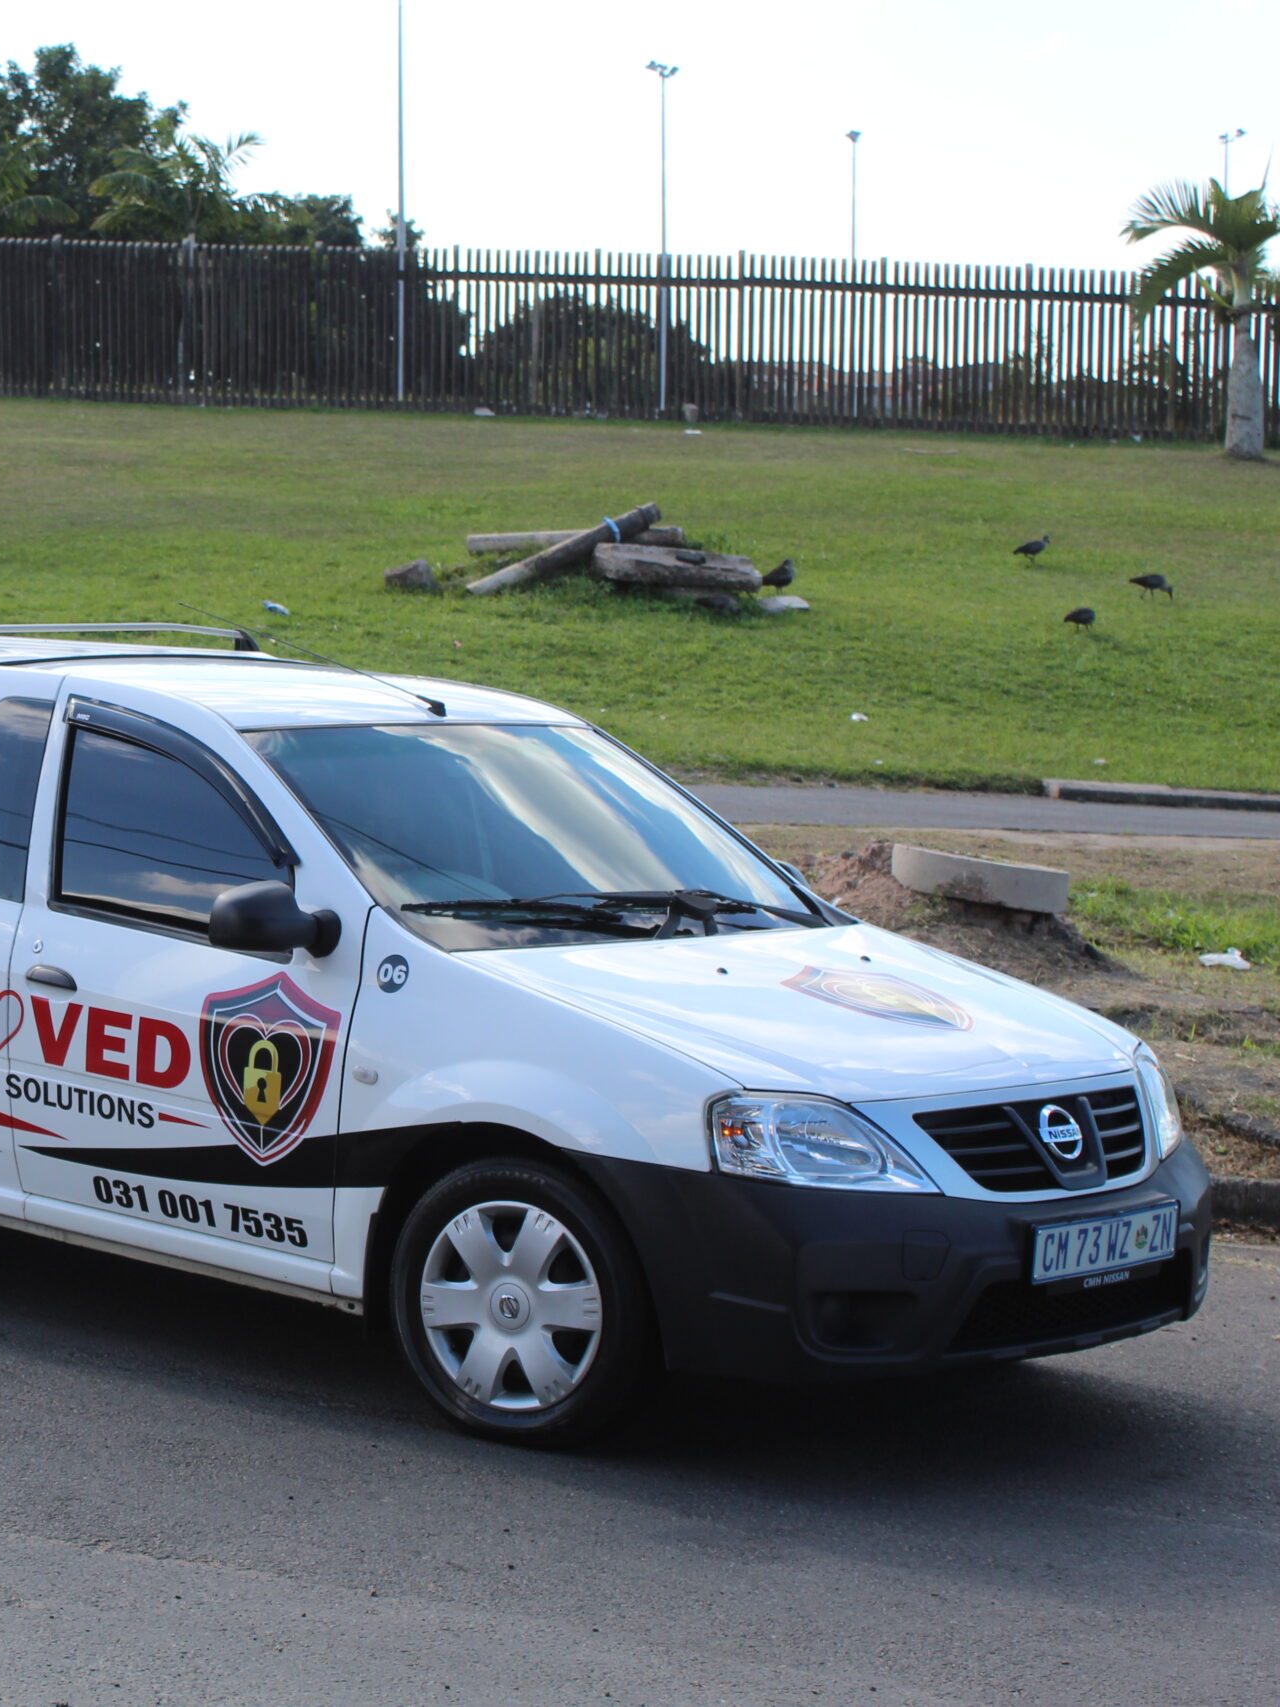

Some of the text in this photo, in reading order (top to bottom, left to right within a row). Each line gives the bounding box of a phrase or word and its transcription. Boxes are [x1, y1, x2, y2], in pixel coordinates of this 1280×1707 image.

[380, 963, 407, 985] 06
[5, 1073, 155, 1129] SOLUTIONS
[93, 1176, 308, 1248] 031 001 7535
[1042, 1212, 1173, 1272] CM 73 WZ ZN
[1083, 1270, 1130, 1288] CMH NISSAN
